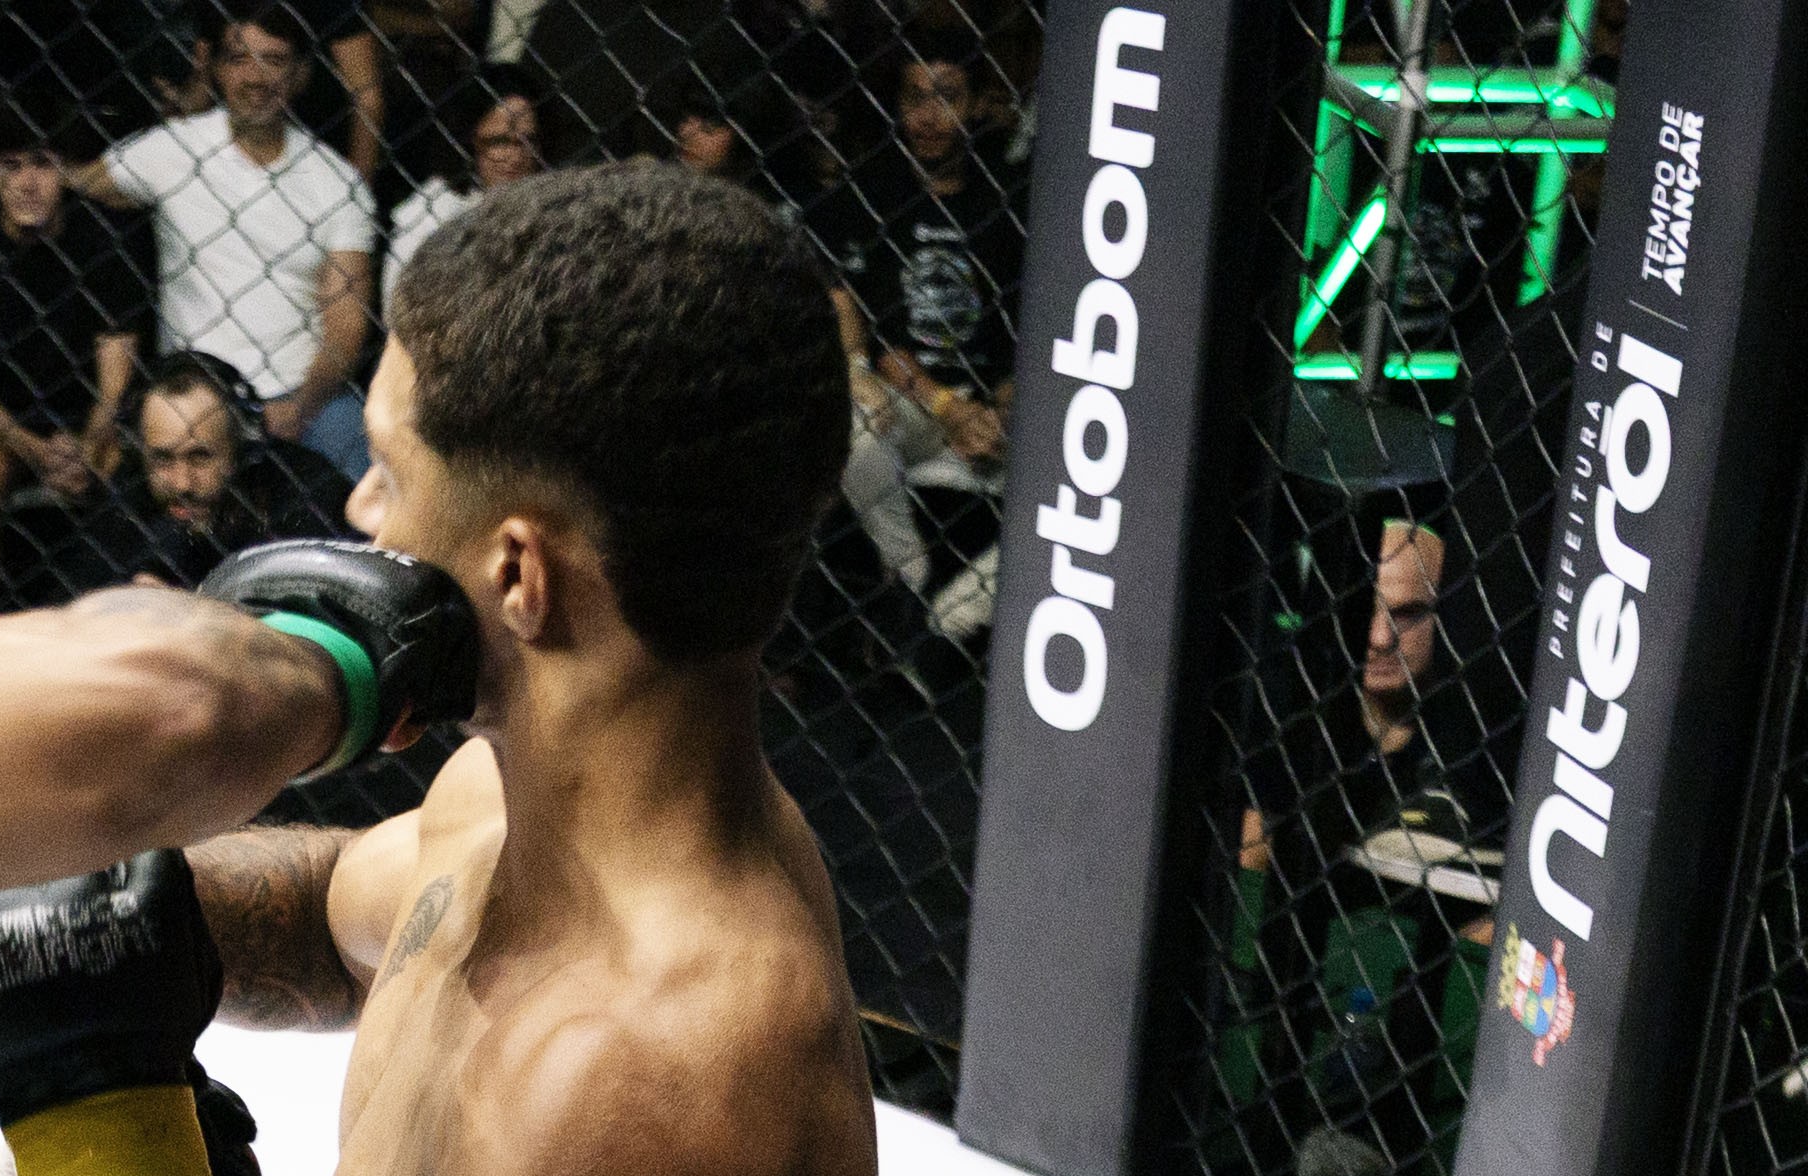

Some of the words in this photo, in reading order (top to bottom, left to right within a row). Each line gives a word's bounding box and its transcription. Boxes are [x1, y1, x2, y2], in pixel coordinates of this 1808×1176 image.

[1641, 160, 1676, 281] TEMPO
[1659, 102, 1684, 153] DE
[1662, 111, 1705, 296] AVANÇAR
[1023, 6, 1166, 732] Ortobom
[1549, 400, 1603, 660] PREFEITURA
[1591, 322, 1614, 373] DE
